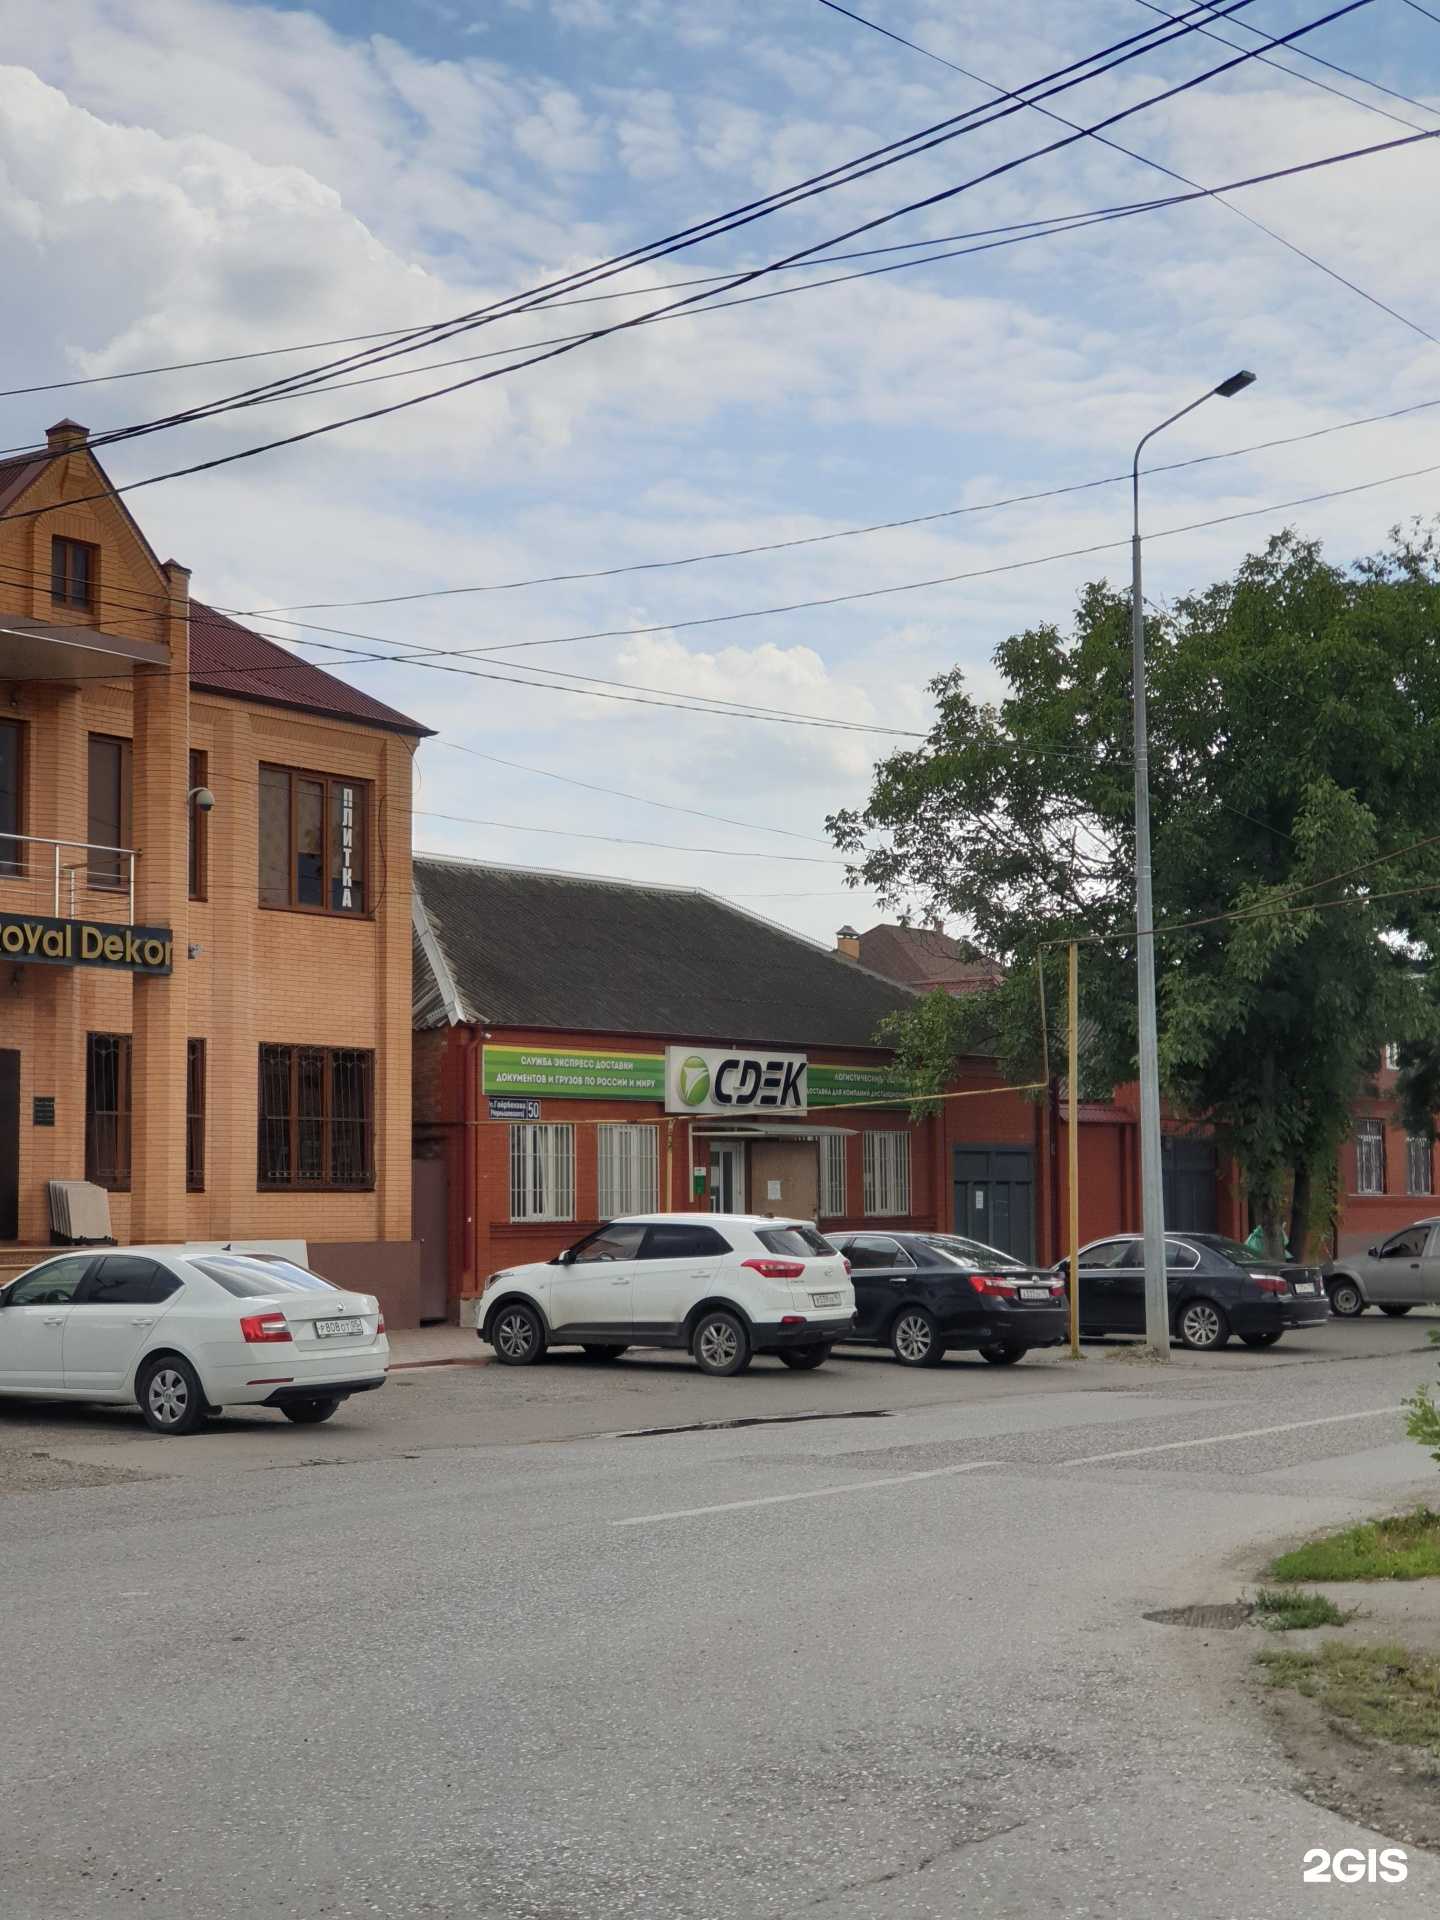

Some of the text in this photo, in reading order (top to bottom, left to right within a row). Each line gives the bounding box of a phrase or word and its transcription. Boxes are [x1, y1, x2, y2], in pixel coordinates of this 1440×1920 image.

[342, 788, 353, 907] ПЛИТКА
[0, 923, 72, 958] oyal
[521, 1056, 633, 1070] СЛУЖБА ЭКСПРЕСС ДОСТАВКИ
[496, 1073, 546, 1084] ДОКУМЕНТОВ
[548, 1075, 554, 1083] И
[555, 1075, 583, 1086] ГРУЗОВ
[584, 1076, 595, 1086] ПО
[596, 1077, 628, 1087] РОССИИ
[629, 1078, 635, 1087] И
[714, 1059, 808, 1107] CDEK
[528, 1102, 539, 1118] 50
